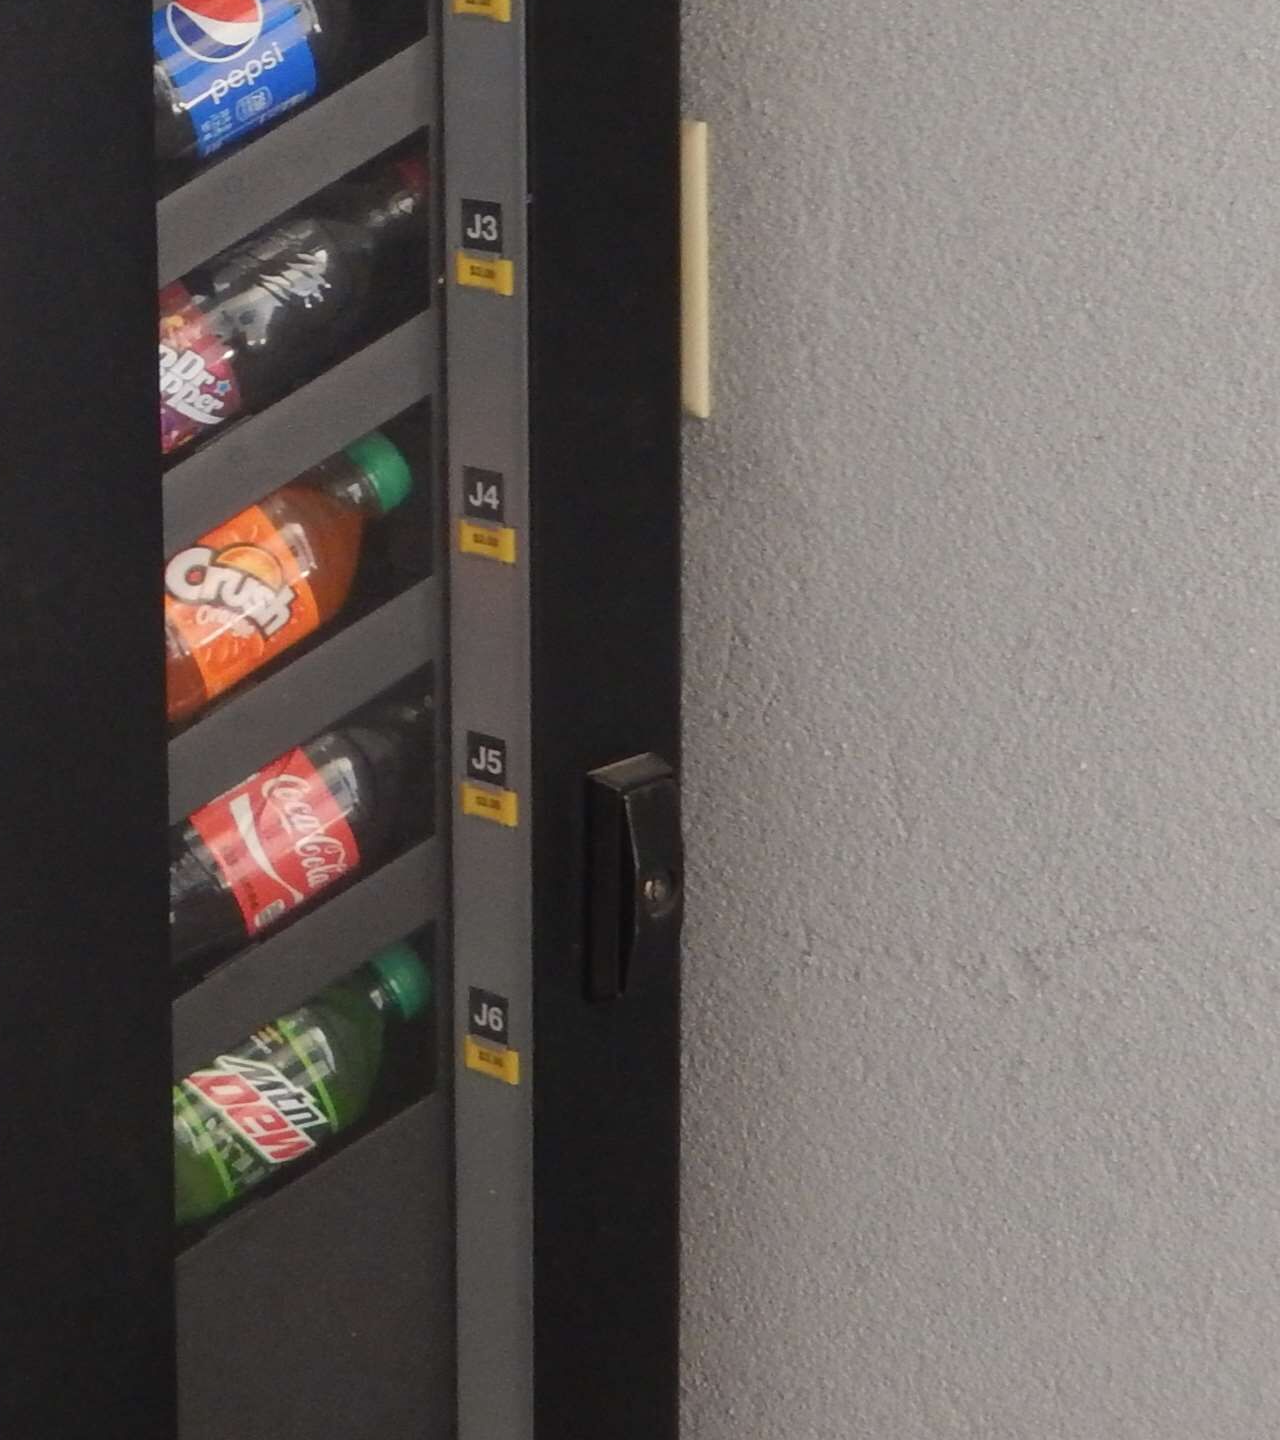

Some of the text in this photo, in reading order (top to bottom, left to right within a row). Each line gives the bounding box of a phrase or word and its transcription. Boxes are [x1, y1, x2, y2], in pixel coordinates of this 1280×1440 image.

[210, 41, 285, 105] pepsi
[466, 214, 499, 243] J3
[172, 349, 217, 389] Dr
[468, 480, 501, 510] J4
[165, 546, 297, 640] Crush
[471, 745, 503, 775] J5
[474, 1002, 505, 1032] J6
